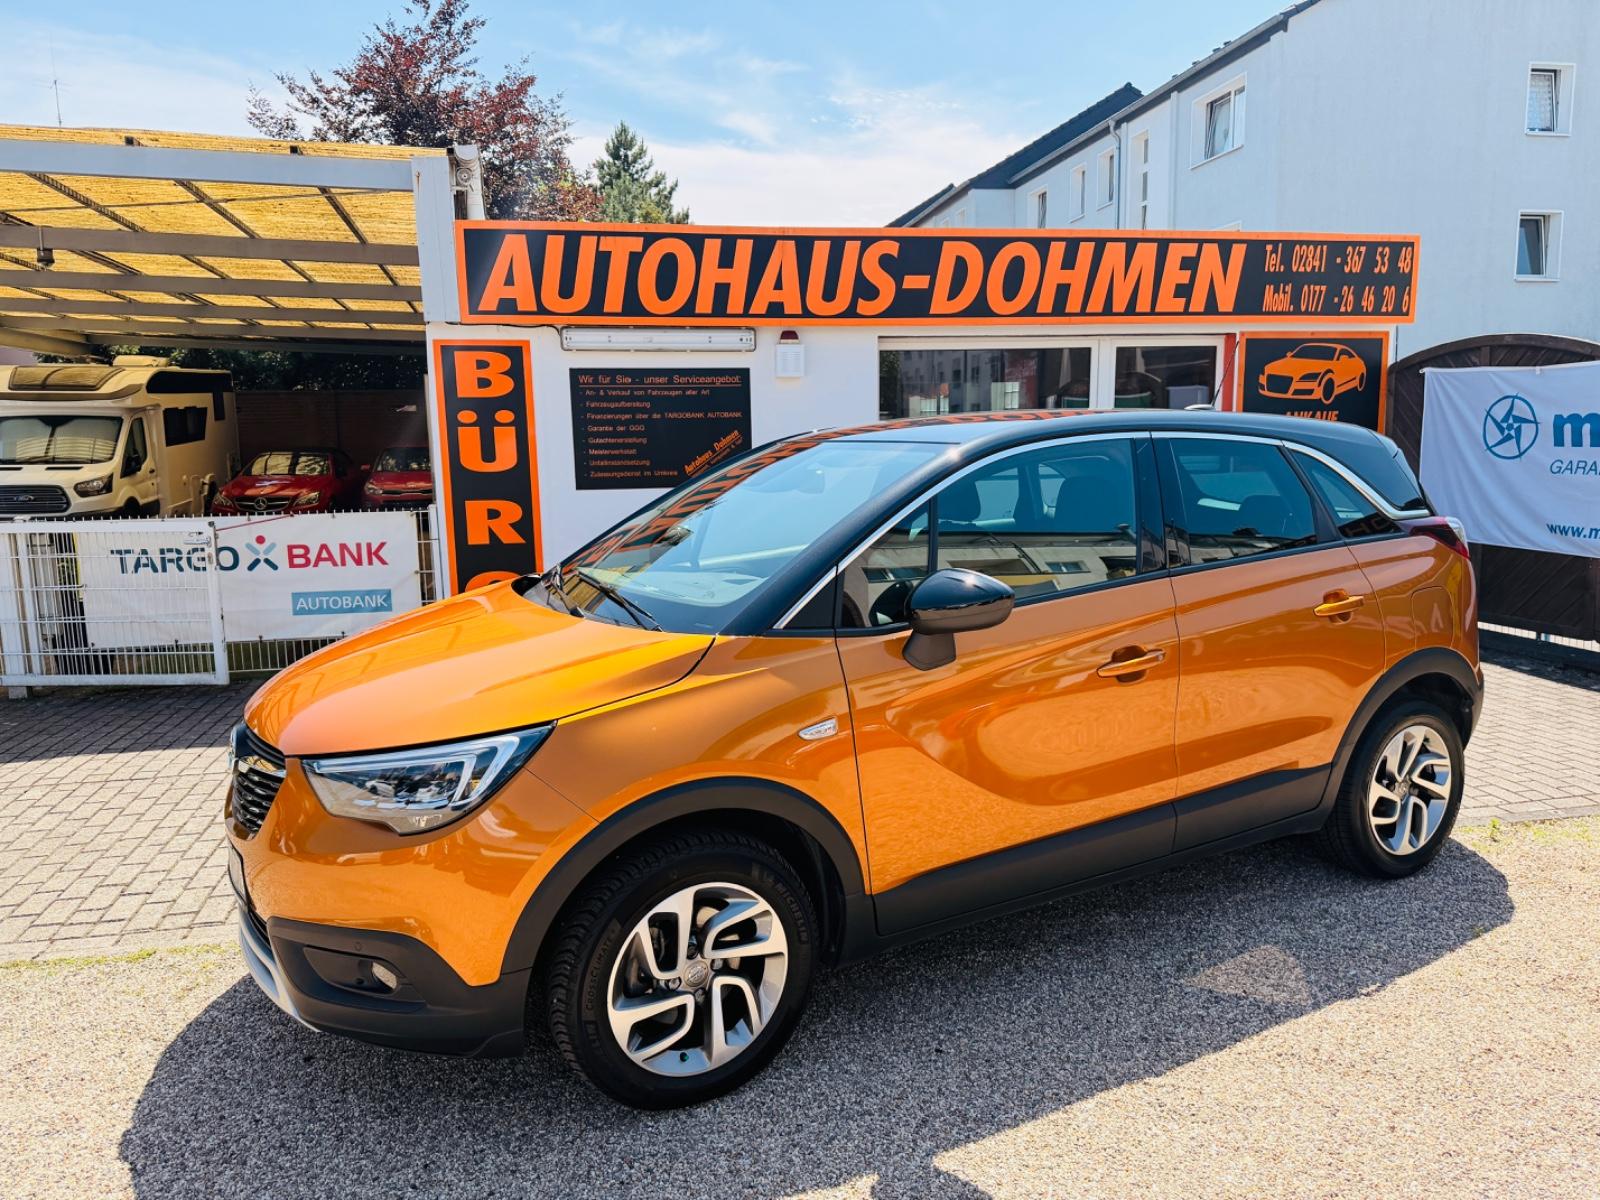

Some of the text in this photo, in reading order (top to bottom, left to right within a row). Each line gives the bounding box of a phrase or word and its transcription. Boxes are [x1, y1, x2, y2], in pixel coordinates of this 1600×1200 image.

[1264, 243, 1285, 273] Tel.
[1291, 244, 1328, 273] 02841
[1373, 247, 1390, 274] 53
[1397, 246, 1413, 274] 48
[478, 233, 1247, 316] AUTOHAUS-DOHMEN
[1262, 283, 1294, 312] Mobil.
[1300, 285, 1328, 313] 0177
[1361, 286, 1375, 313] 46
[1380, 286, 1396, 313] 20
[1402, 286, 1410, 313] 6
[578, 374, 594, 384] Wir
[598, 374, 611, 384] für
[615, 374, 632, 384] Sie
[643, 375, 669, 384] unser
[647, 389, 683, 397] Fahrzeugen
[664, 411, 705, 419] TARGOBANK
[684, 450, 714, 474] Autohaus
[713, 430, 740, 451] Dohmen
[1550, 459, 1600, 475] GARA
[287, 541, 389, 569] BANK
[296, 594, 388, 610] AUTOBANK
